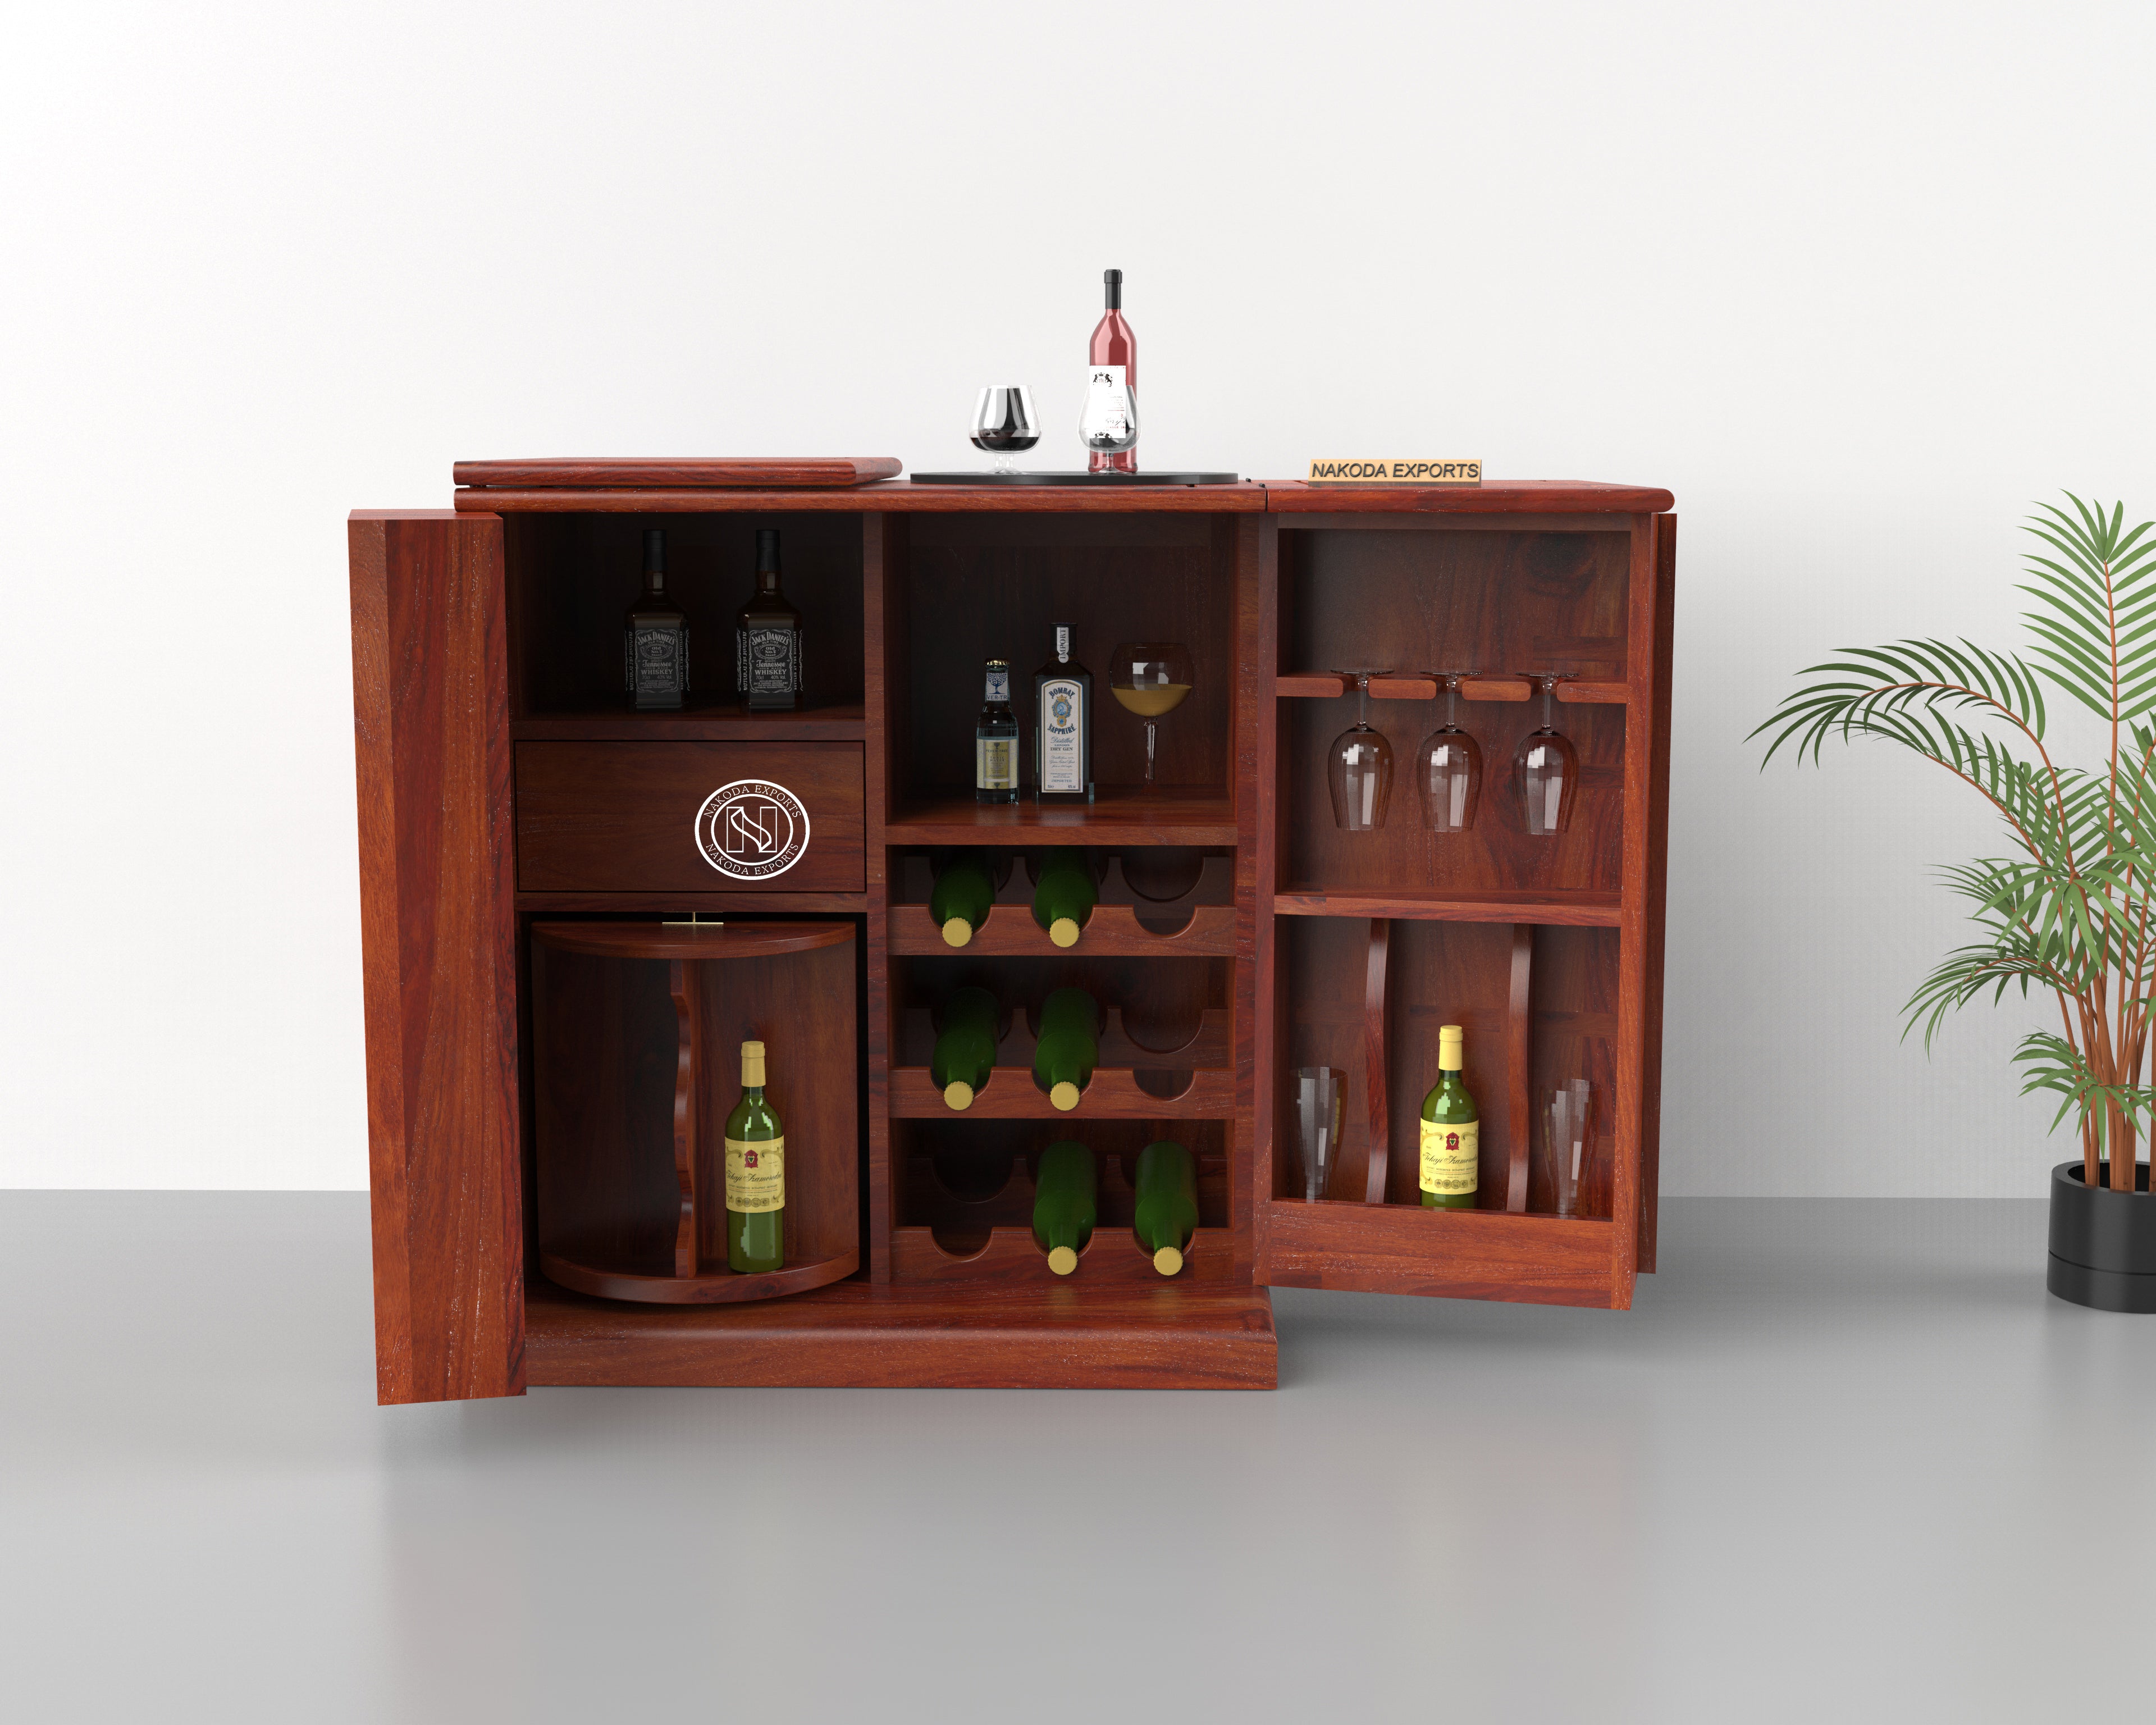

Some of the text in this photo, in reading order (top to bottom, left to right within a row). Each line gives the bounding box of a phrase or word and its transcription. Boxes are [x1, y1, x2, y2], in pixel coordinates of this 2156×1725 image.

[1312, 463, 1478, 478] NAKODA EXPORTS
[637, 632, 676, 645] JACK DANIEL'S
[751, 632, 789, 645] JACK DANIEL'S
[1049, 687, 1075, 699] BOMBAY
[1047, 723, 1076, 734] SAPPHIRE
